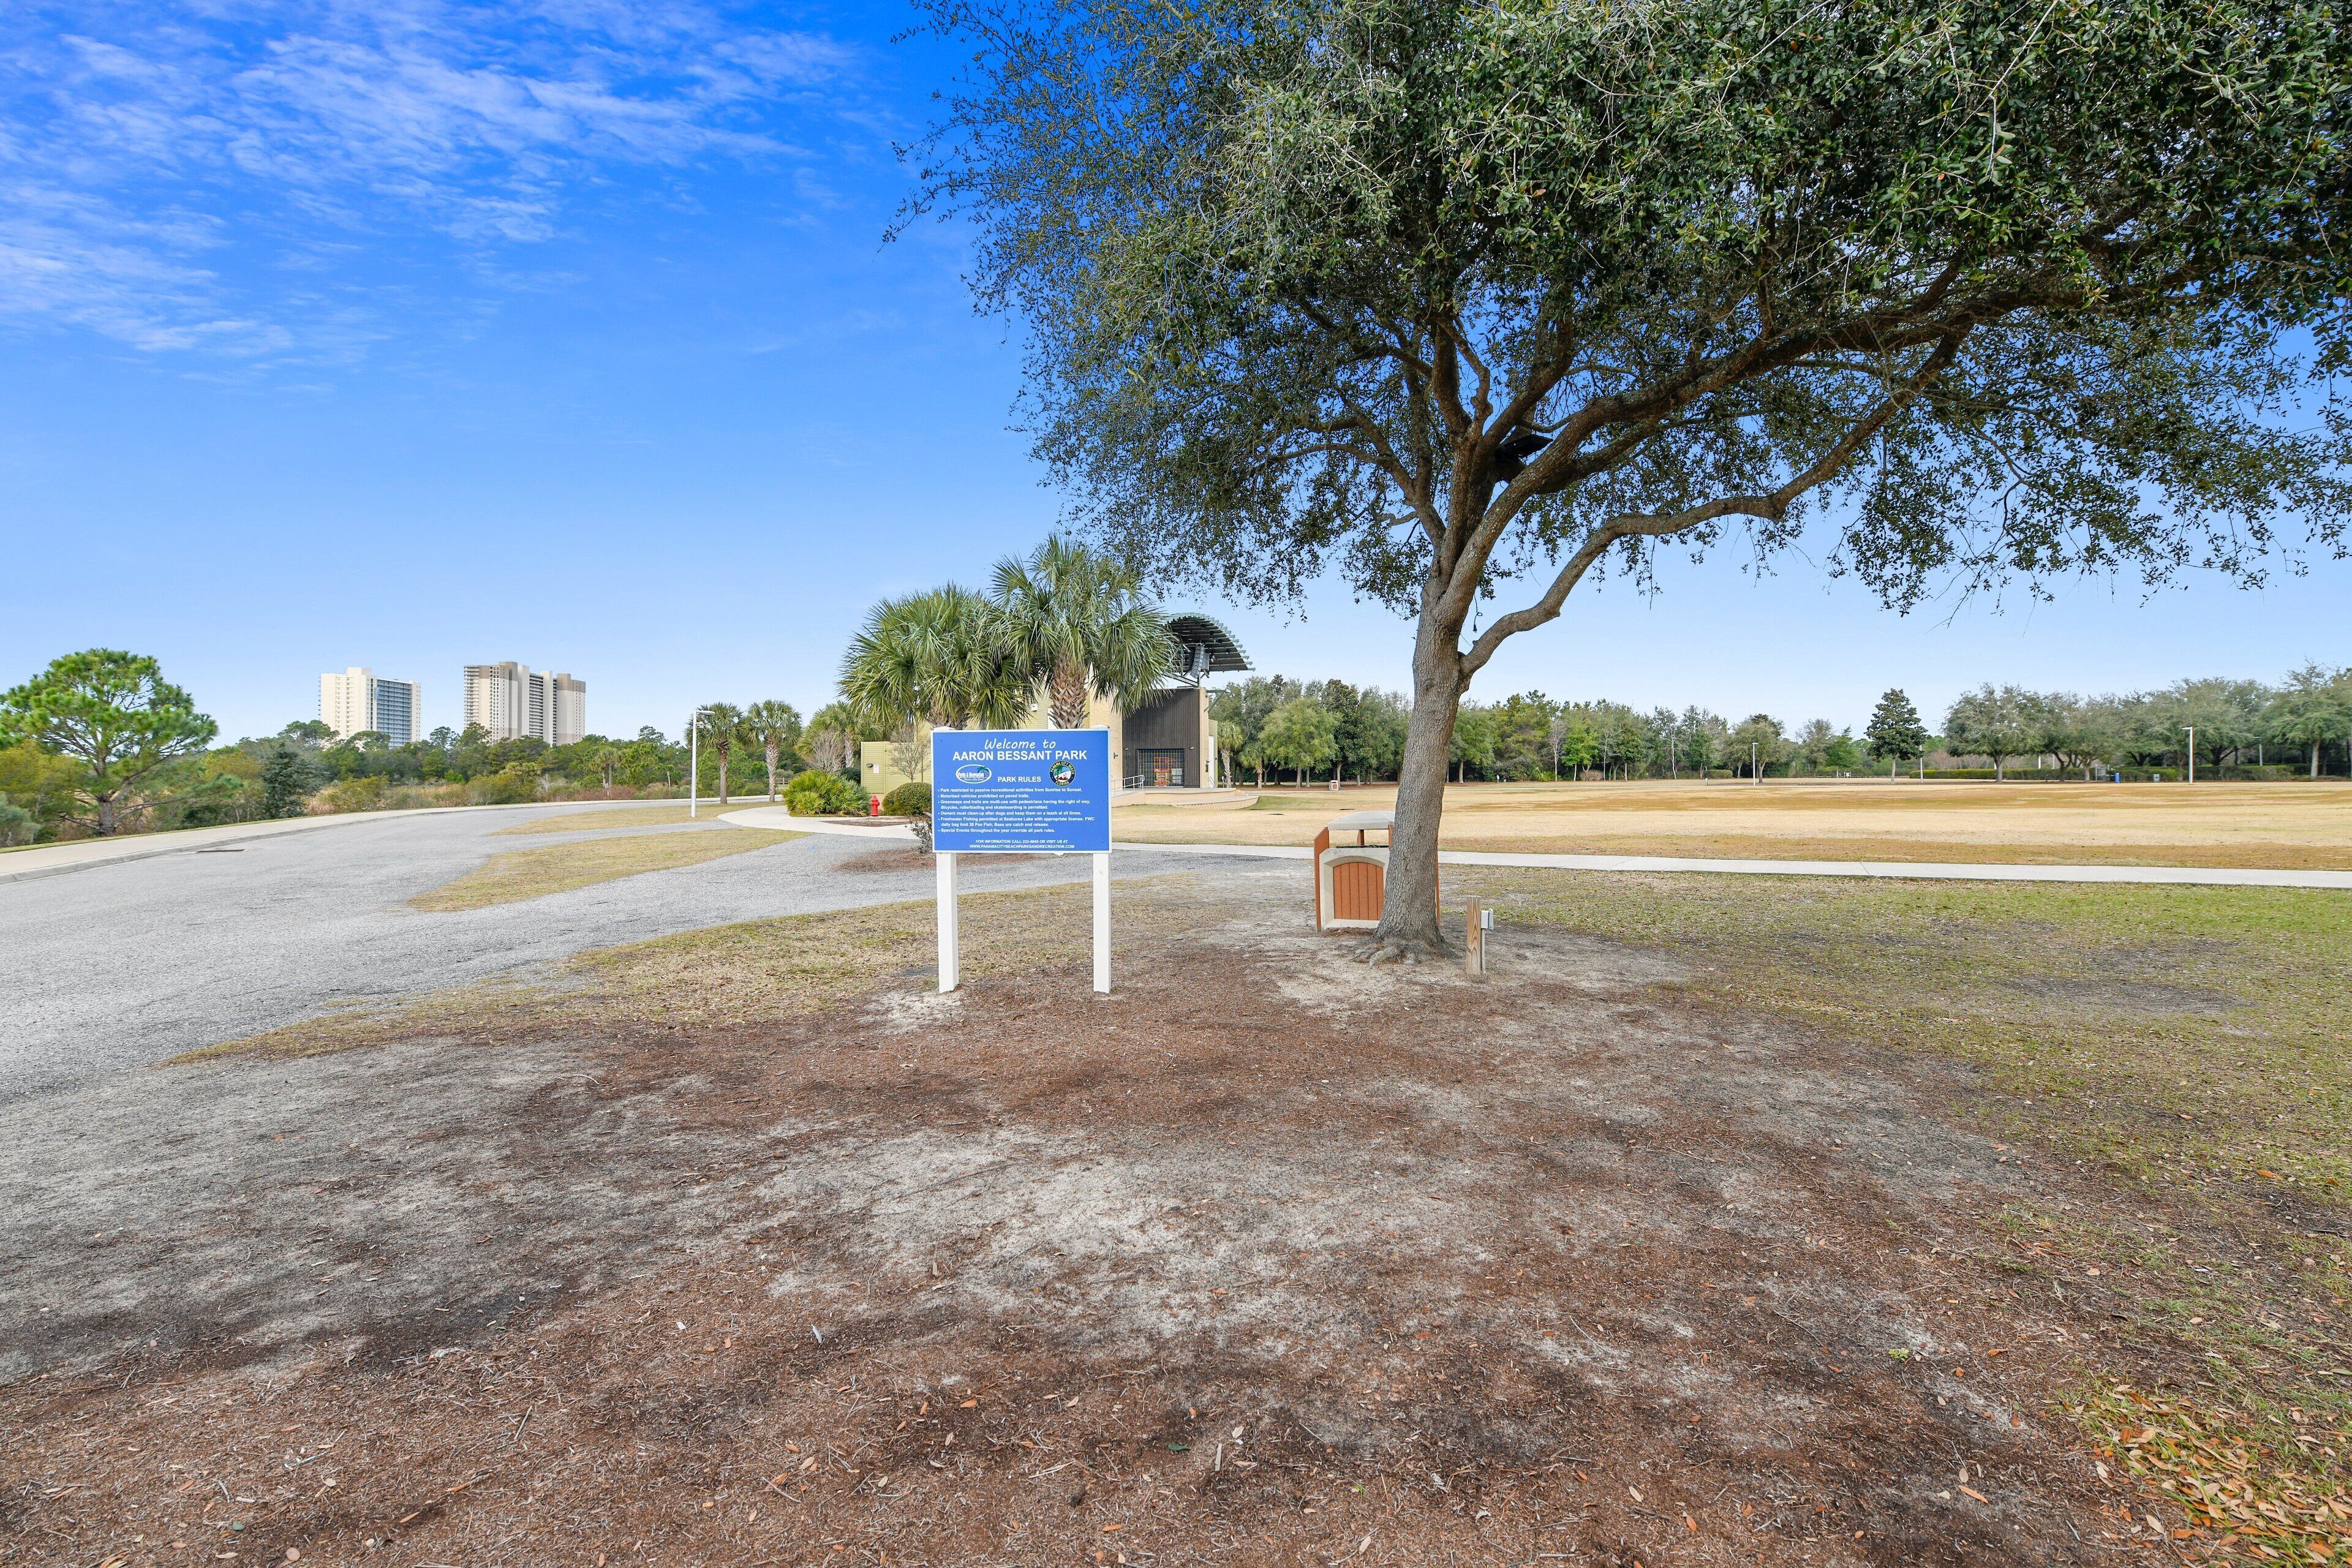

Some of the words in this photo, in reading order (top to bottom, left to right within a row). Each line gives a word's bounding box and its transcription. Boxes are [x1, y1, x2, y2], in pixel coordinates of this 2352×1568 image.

[984, 738, 1036, 750] Welcome
[1042, 739, 1056, 748] to
[952, 751, 993, 761] AARON
[997, 750, 1052, 760] BESSANT
[1055, 750, 1087, 760] PARK
